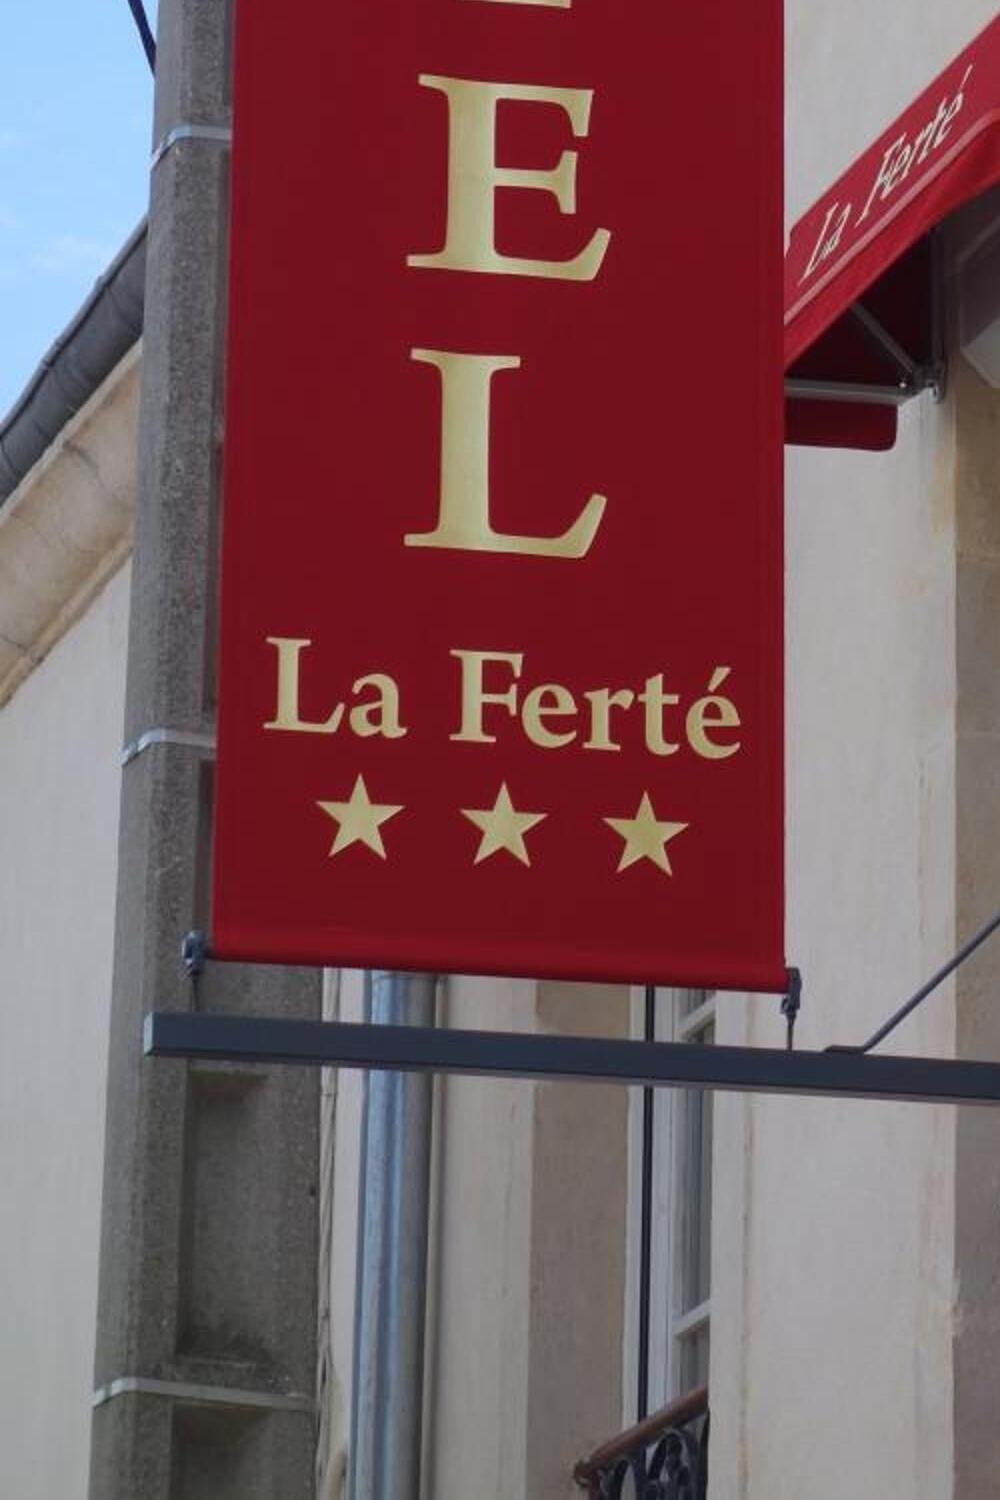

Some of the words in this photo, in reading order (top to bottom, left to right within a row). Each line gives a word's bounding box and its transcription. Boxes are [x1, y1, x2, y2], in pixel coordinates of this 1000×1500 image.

[797, 201, 852, 287] La
[263, 637, 407, 739] La
[449, 649, 741, 759] Ferté
